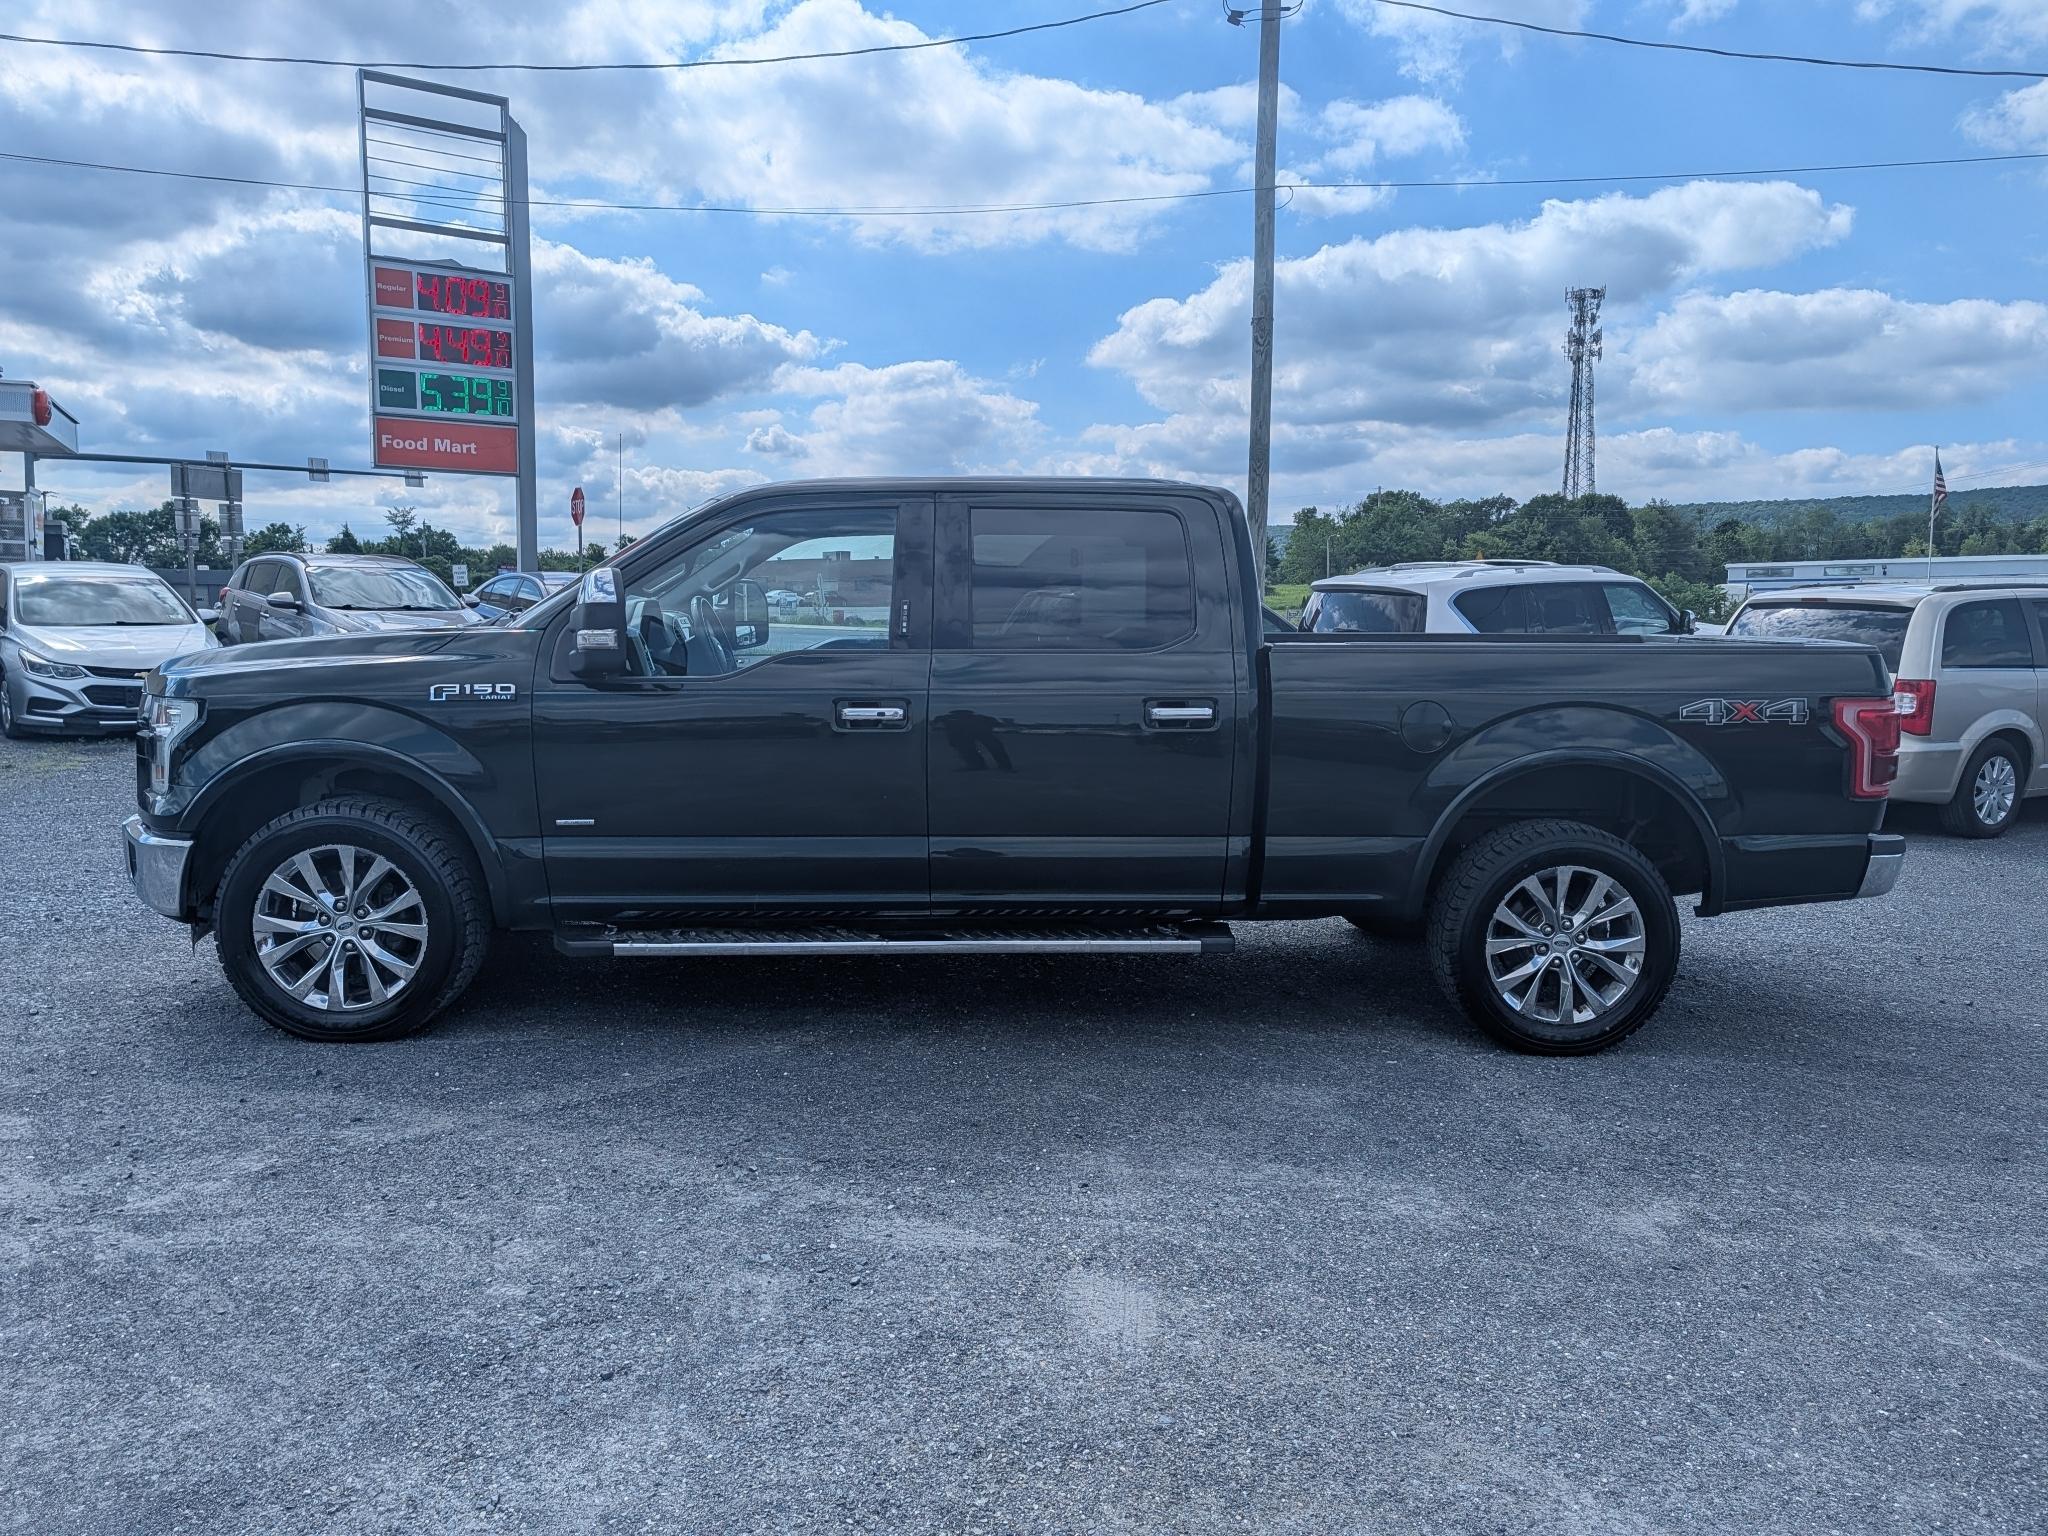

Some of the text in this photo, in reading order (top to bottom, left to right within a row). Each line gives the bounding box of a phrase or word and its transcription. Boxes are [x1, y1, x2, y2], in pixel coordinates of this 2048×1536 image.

[377, 282, 407, 292] Regular
[417, 275, 490, 318] 4.09
[379, 334, 414, 344] Premium
[419, 325, 492, 367] 4.49
[380, 384, 405, 393] Diesel
[420, 373, 493, 415] 5.39
[381, 434, 477, 455] Food Mart
[572, 499, 584, 514] STOP
